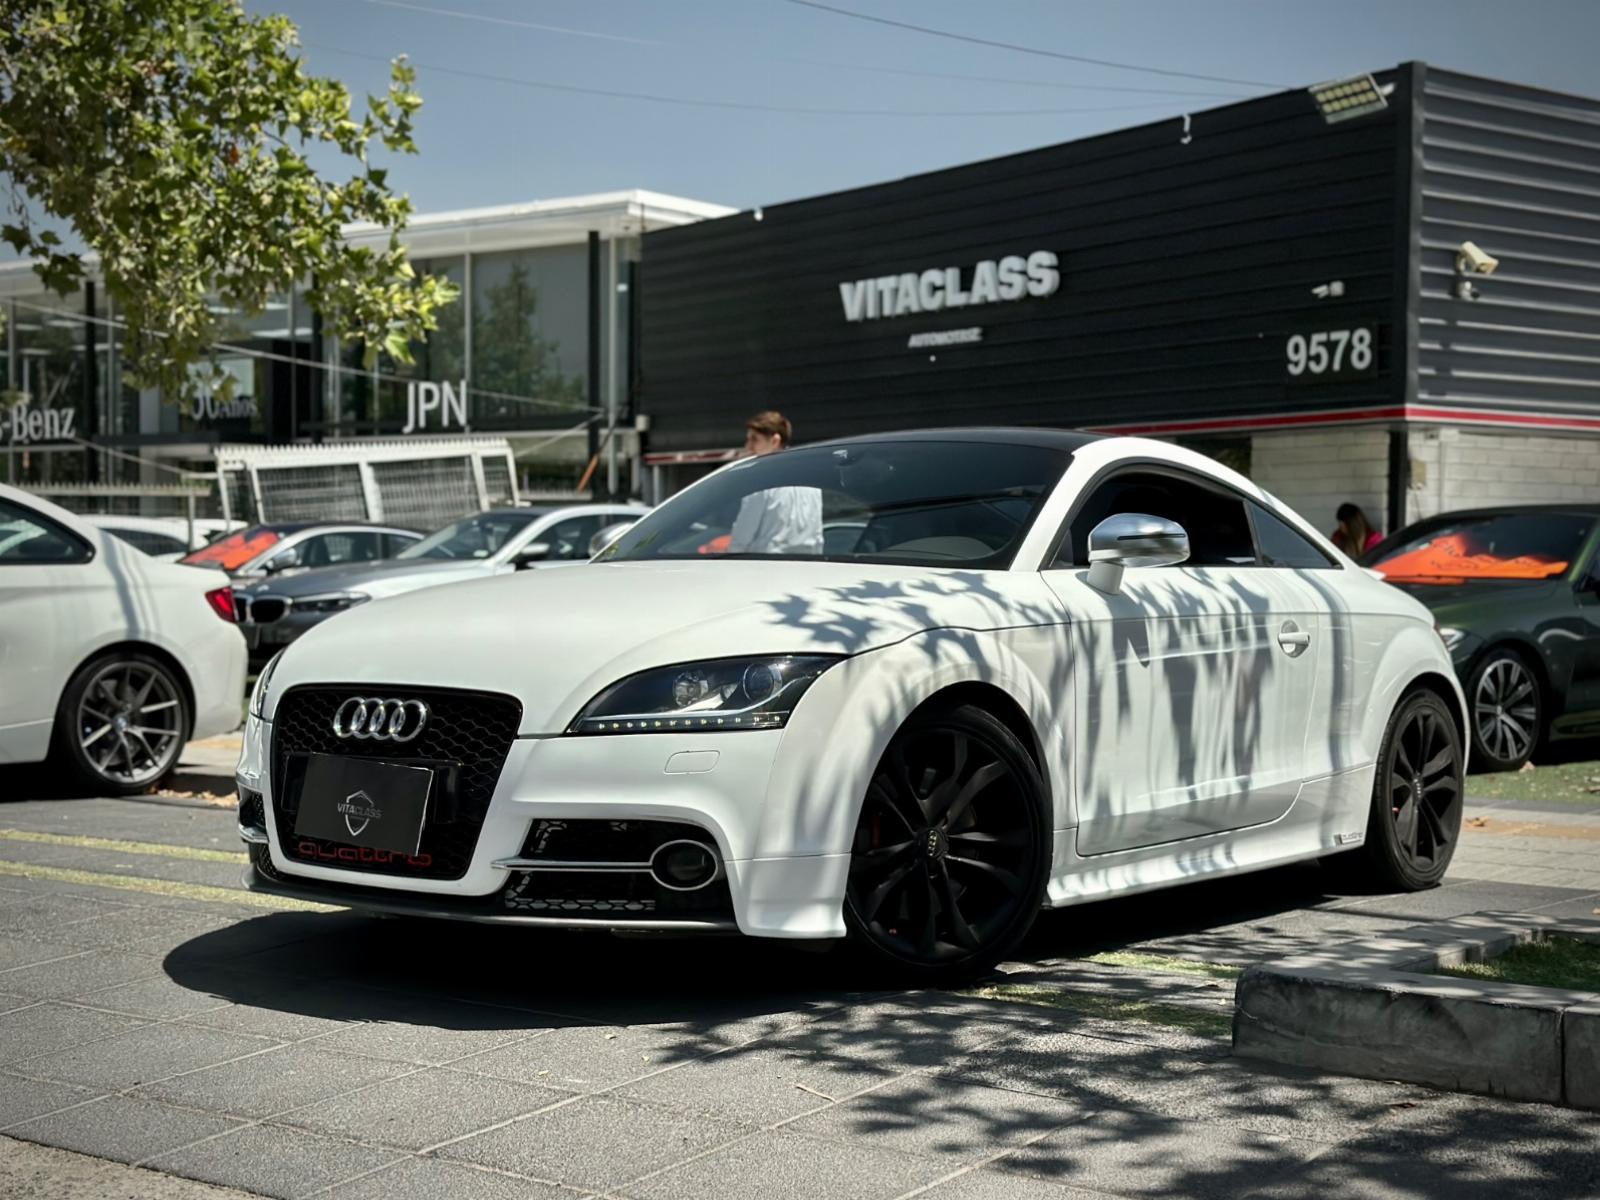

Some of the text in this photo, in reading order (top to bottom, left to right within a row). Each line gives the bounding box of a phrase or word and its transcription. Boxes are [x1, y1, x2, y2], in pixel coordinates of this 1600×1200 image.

[839, 250, 1060, 322] VITACLASS
[1286, 327, 1372, 375] 9578
[0, 403, 76, 441] -Benz
[402, 380, 467, 434] JPN
[337, 802, 382, 819] VITACLASS
[298, 841, 432, 866] quattro
